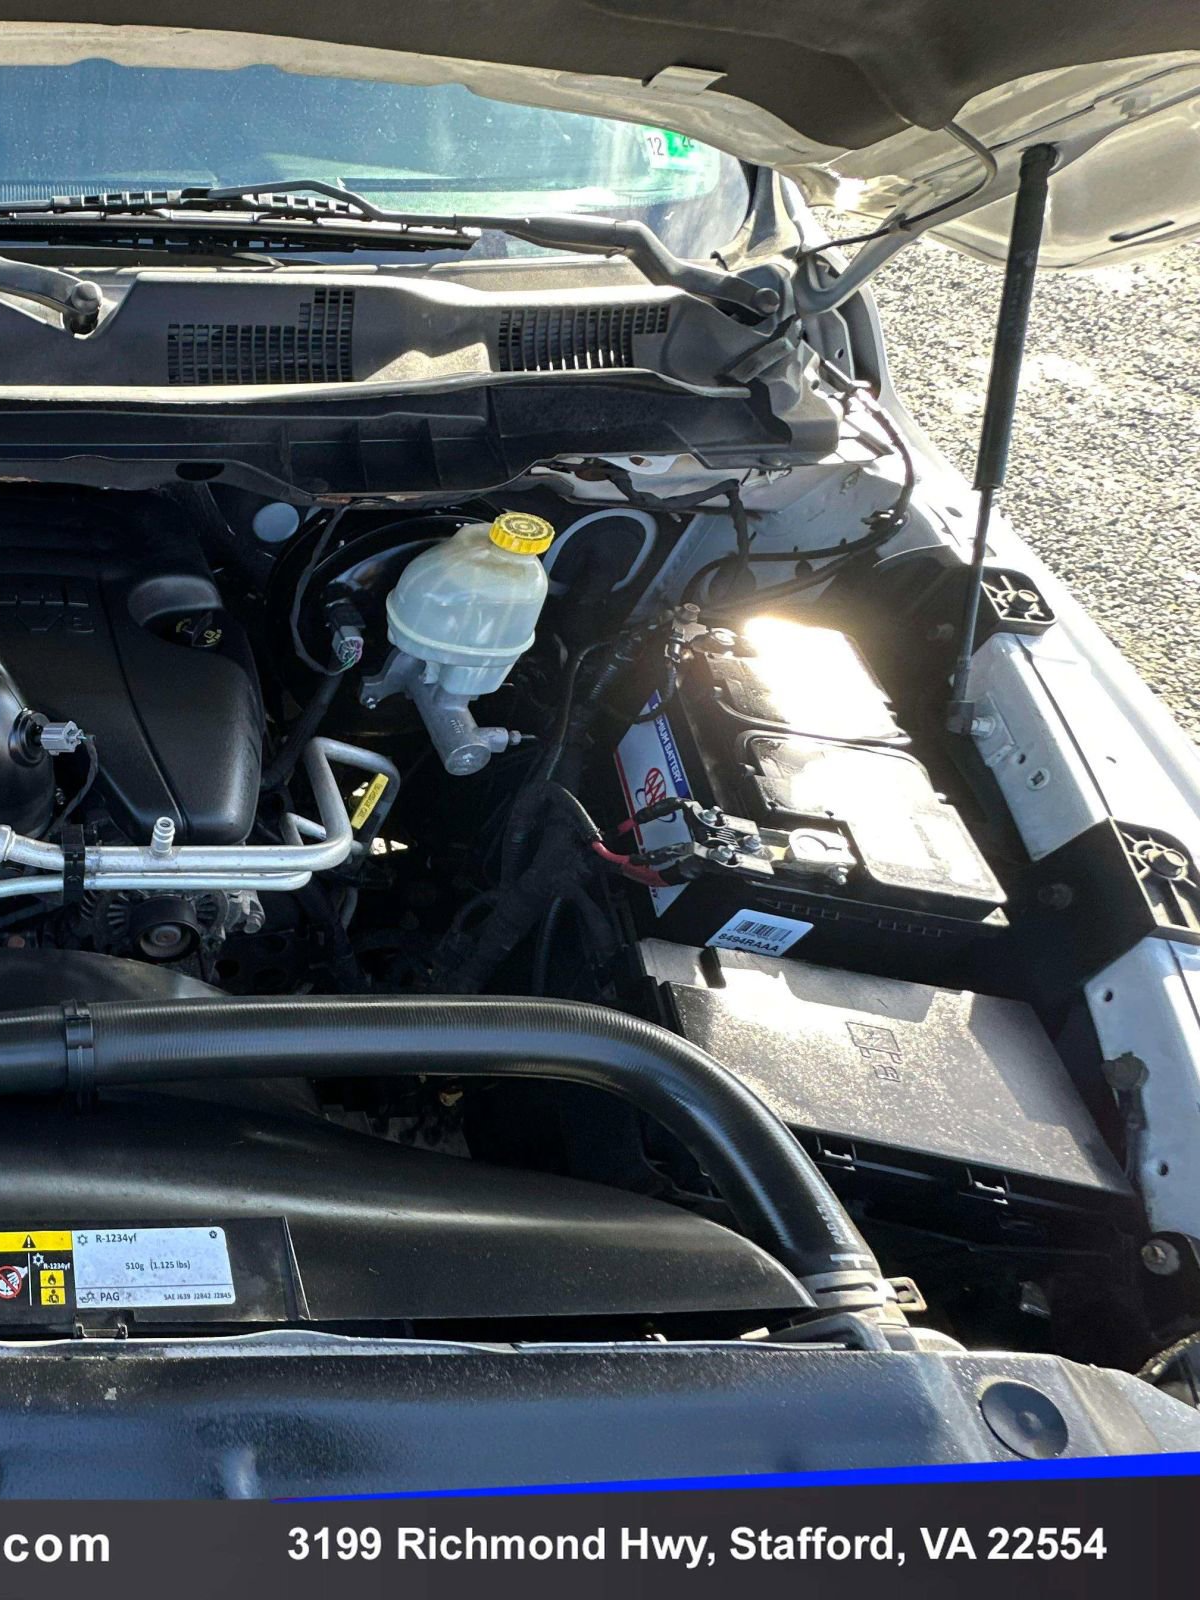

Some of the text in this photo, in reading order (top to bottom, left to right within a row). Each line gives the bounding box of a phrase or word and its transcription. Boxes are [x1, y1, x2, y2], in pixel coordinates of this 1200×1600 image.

[647, 136, 664, 155] 12
[663, 741, 683, 784] BATTERY
[95, 1233, 137, 1245] R-1234yf
[125, 1259, 191, 1271] 510g (1.125 lbs)
[100, 1292, 120, 1301] PAG
